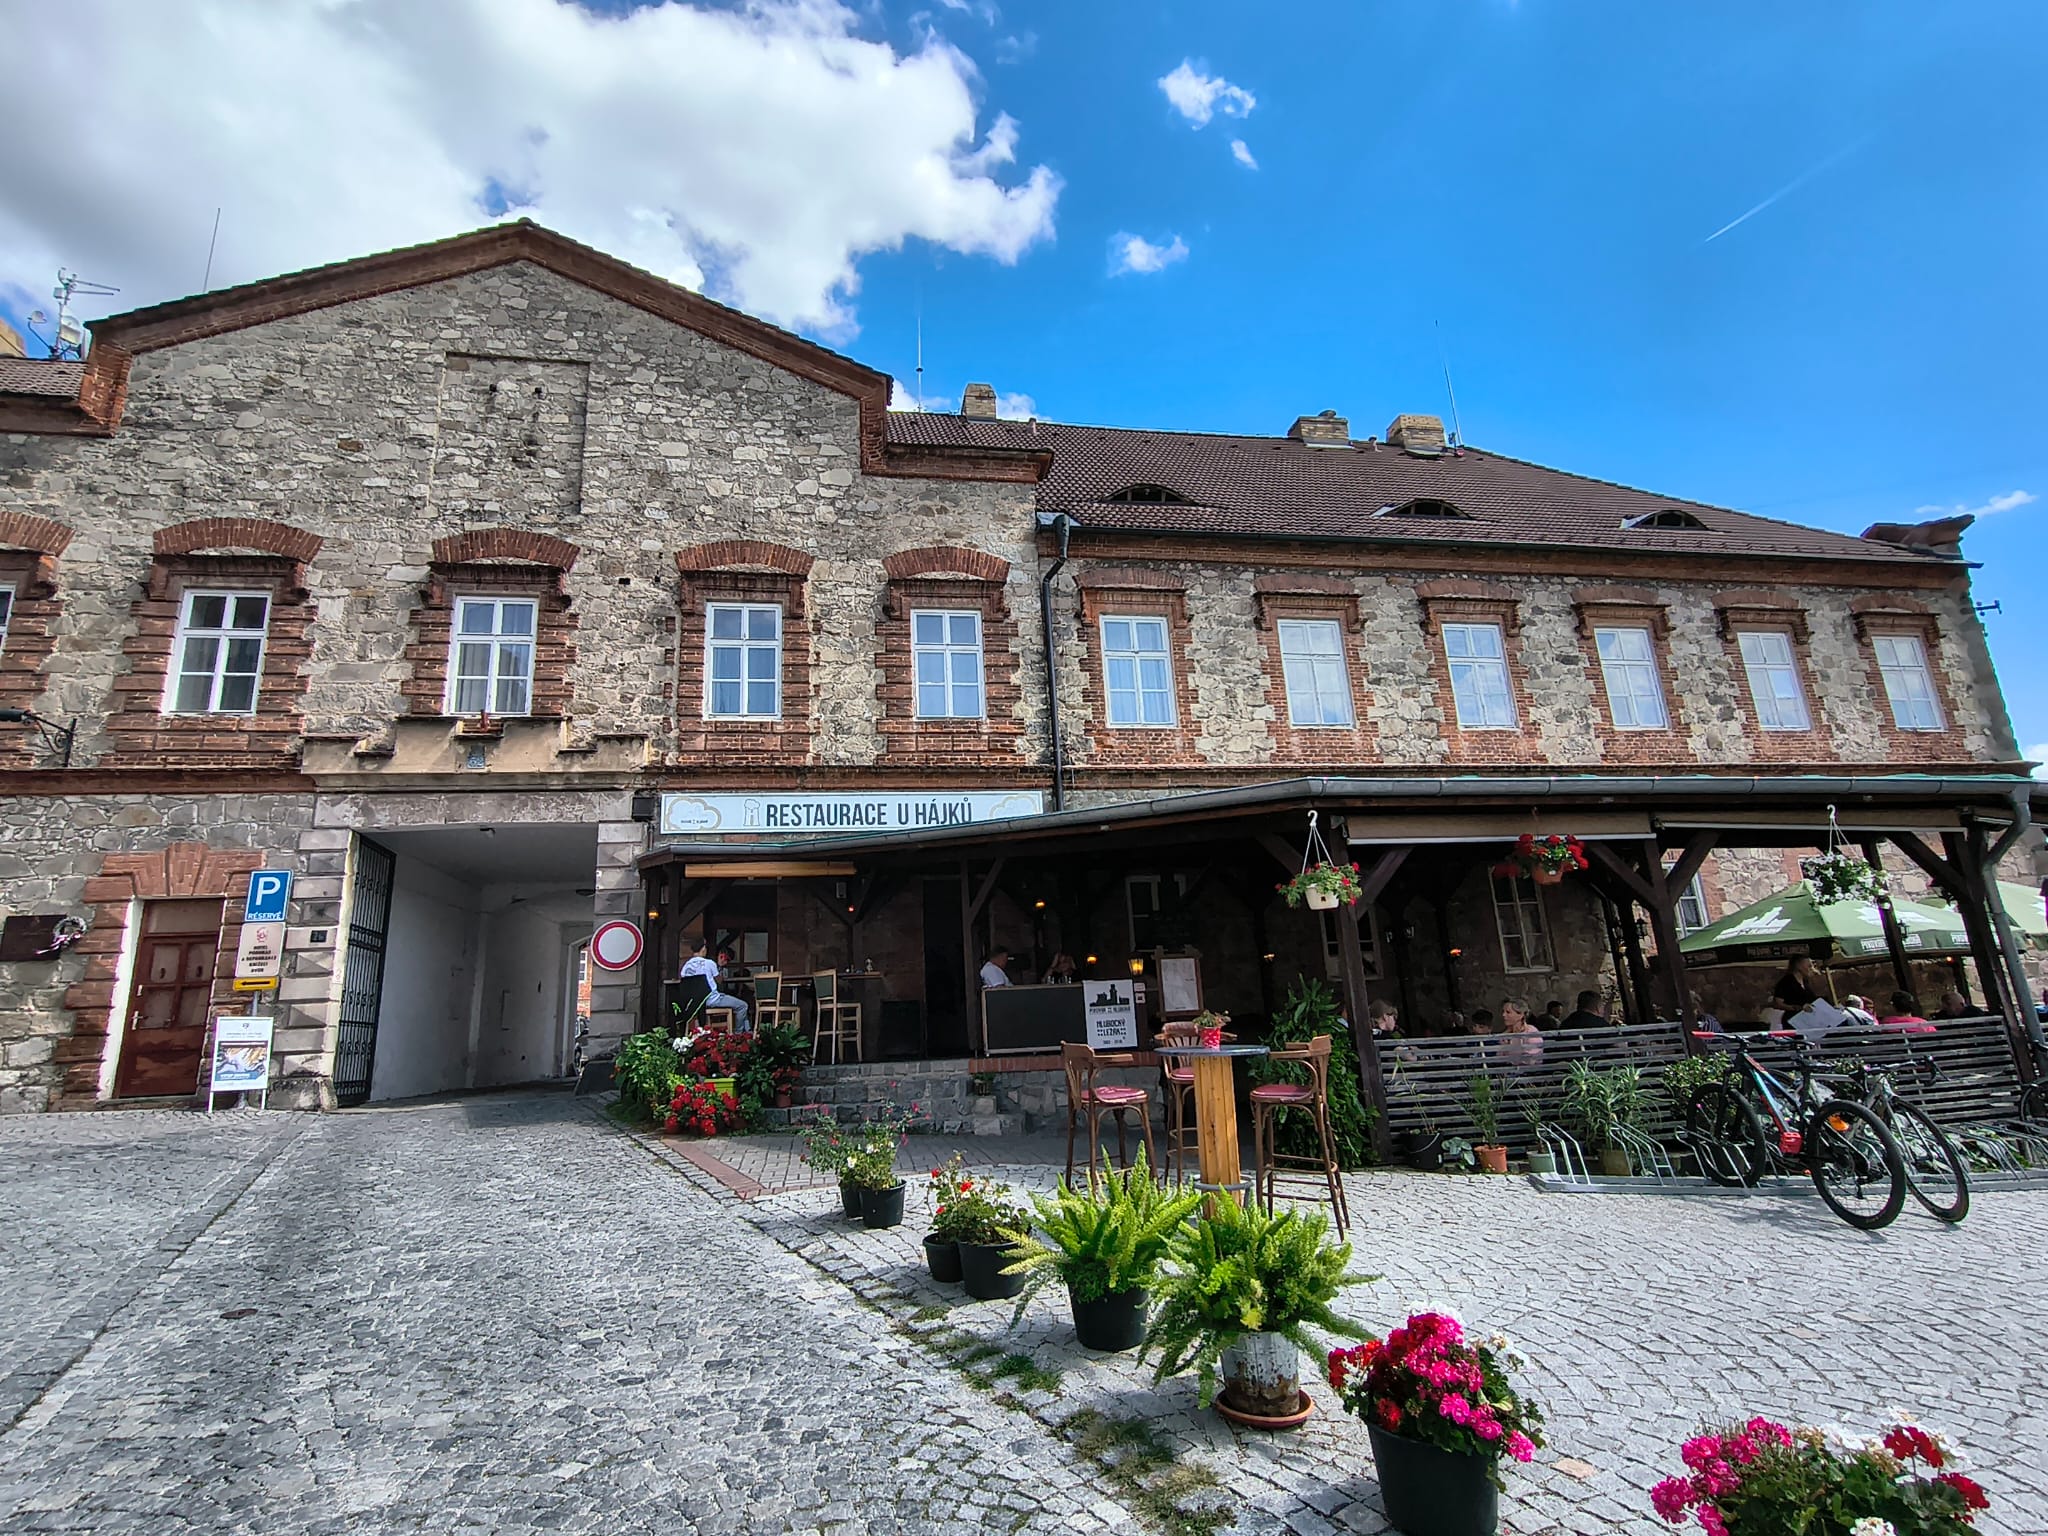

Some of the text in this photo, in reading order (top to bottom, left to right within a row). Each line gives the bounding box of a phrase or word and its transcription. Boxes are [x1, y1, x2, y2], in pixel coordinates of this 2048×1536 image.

[766, 797, 972, 827] RESTAURACE U HÁJKŮ
[256, 877, 280, 905] P
